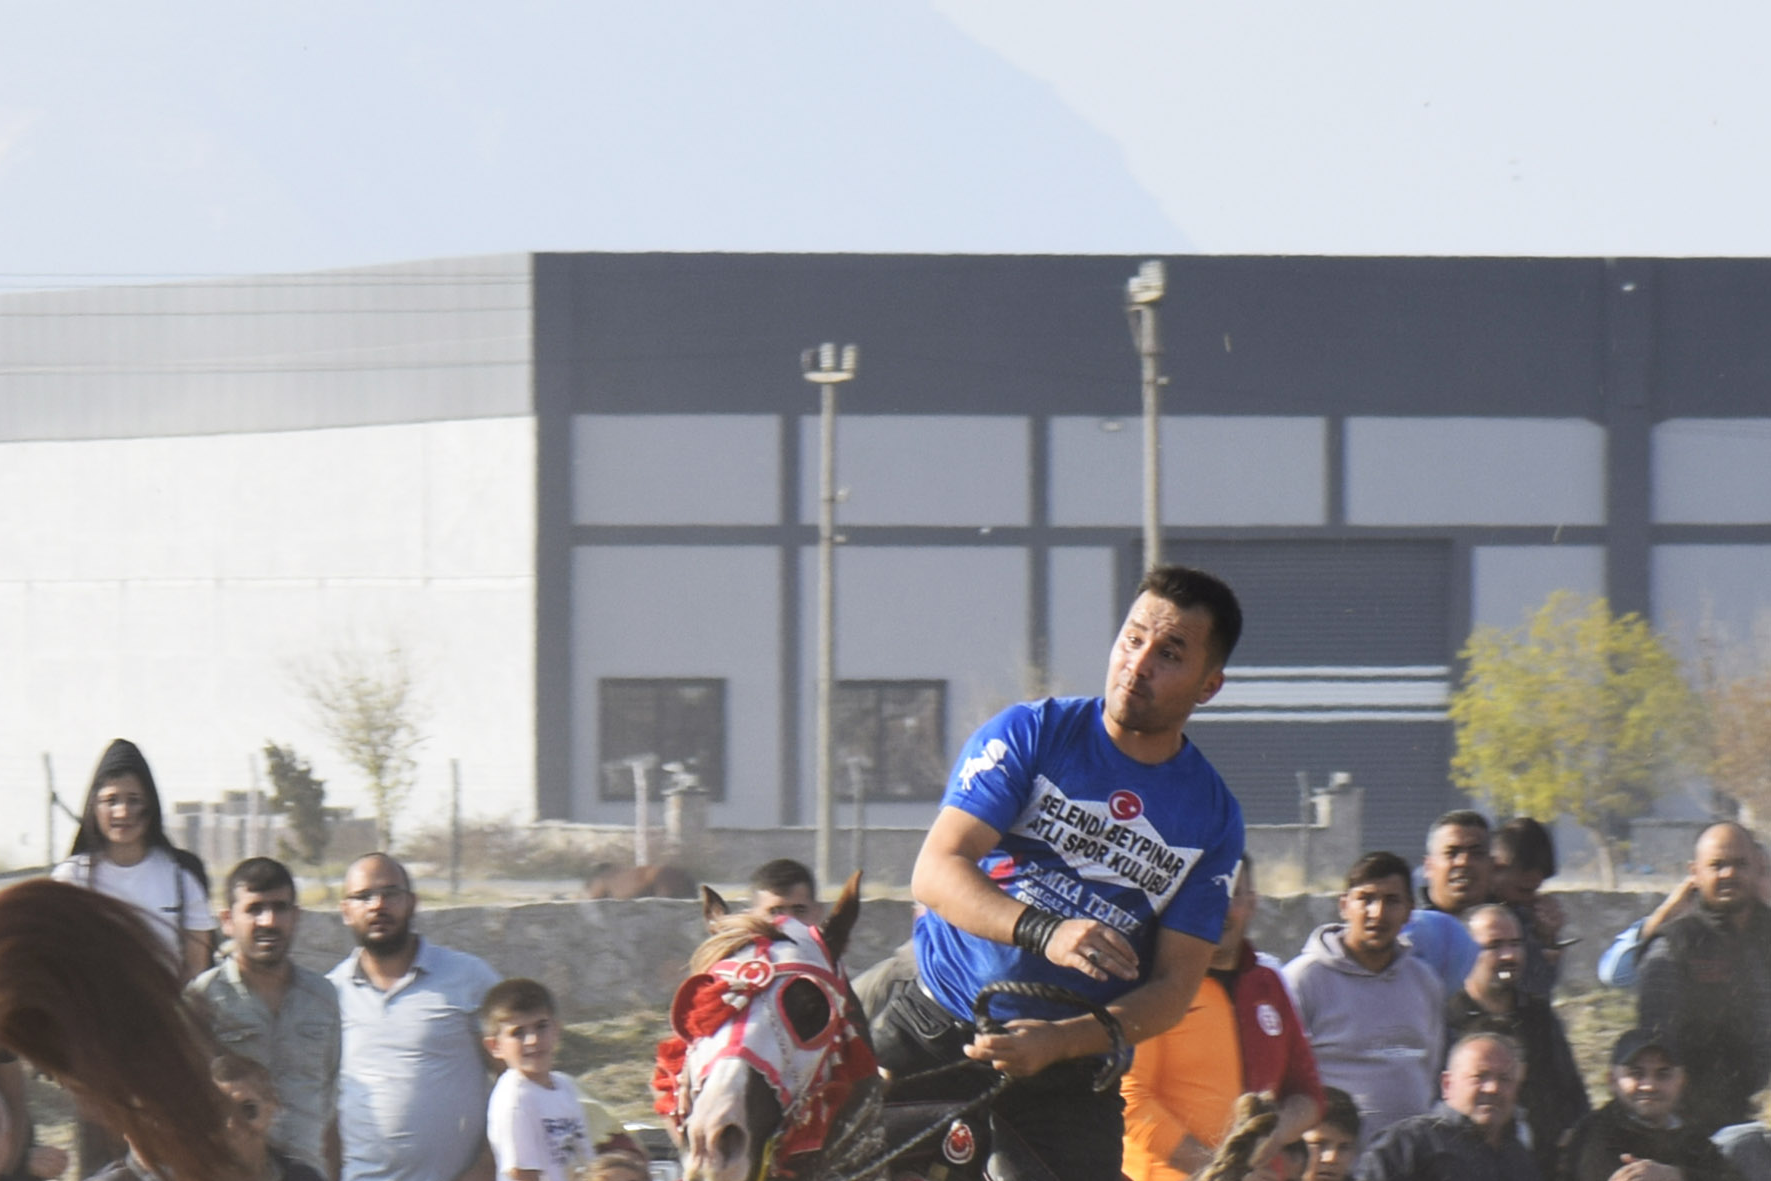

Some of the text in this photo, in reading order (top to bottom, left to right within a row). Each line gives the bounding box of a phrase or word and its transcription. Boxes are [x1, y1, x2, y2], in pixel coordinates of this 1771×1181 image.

[1026, 816, 1173, 896] ATLI SPOR KULÜBÜ
[1039, 793, 1185, 878] SELENDİ BEYPINAR
